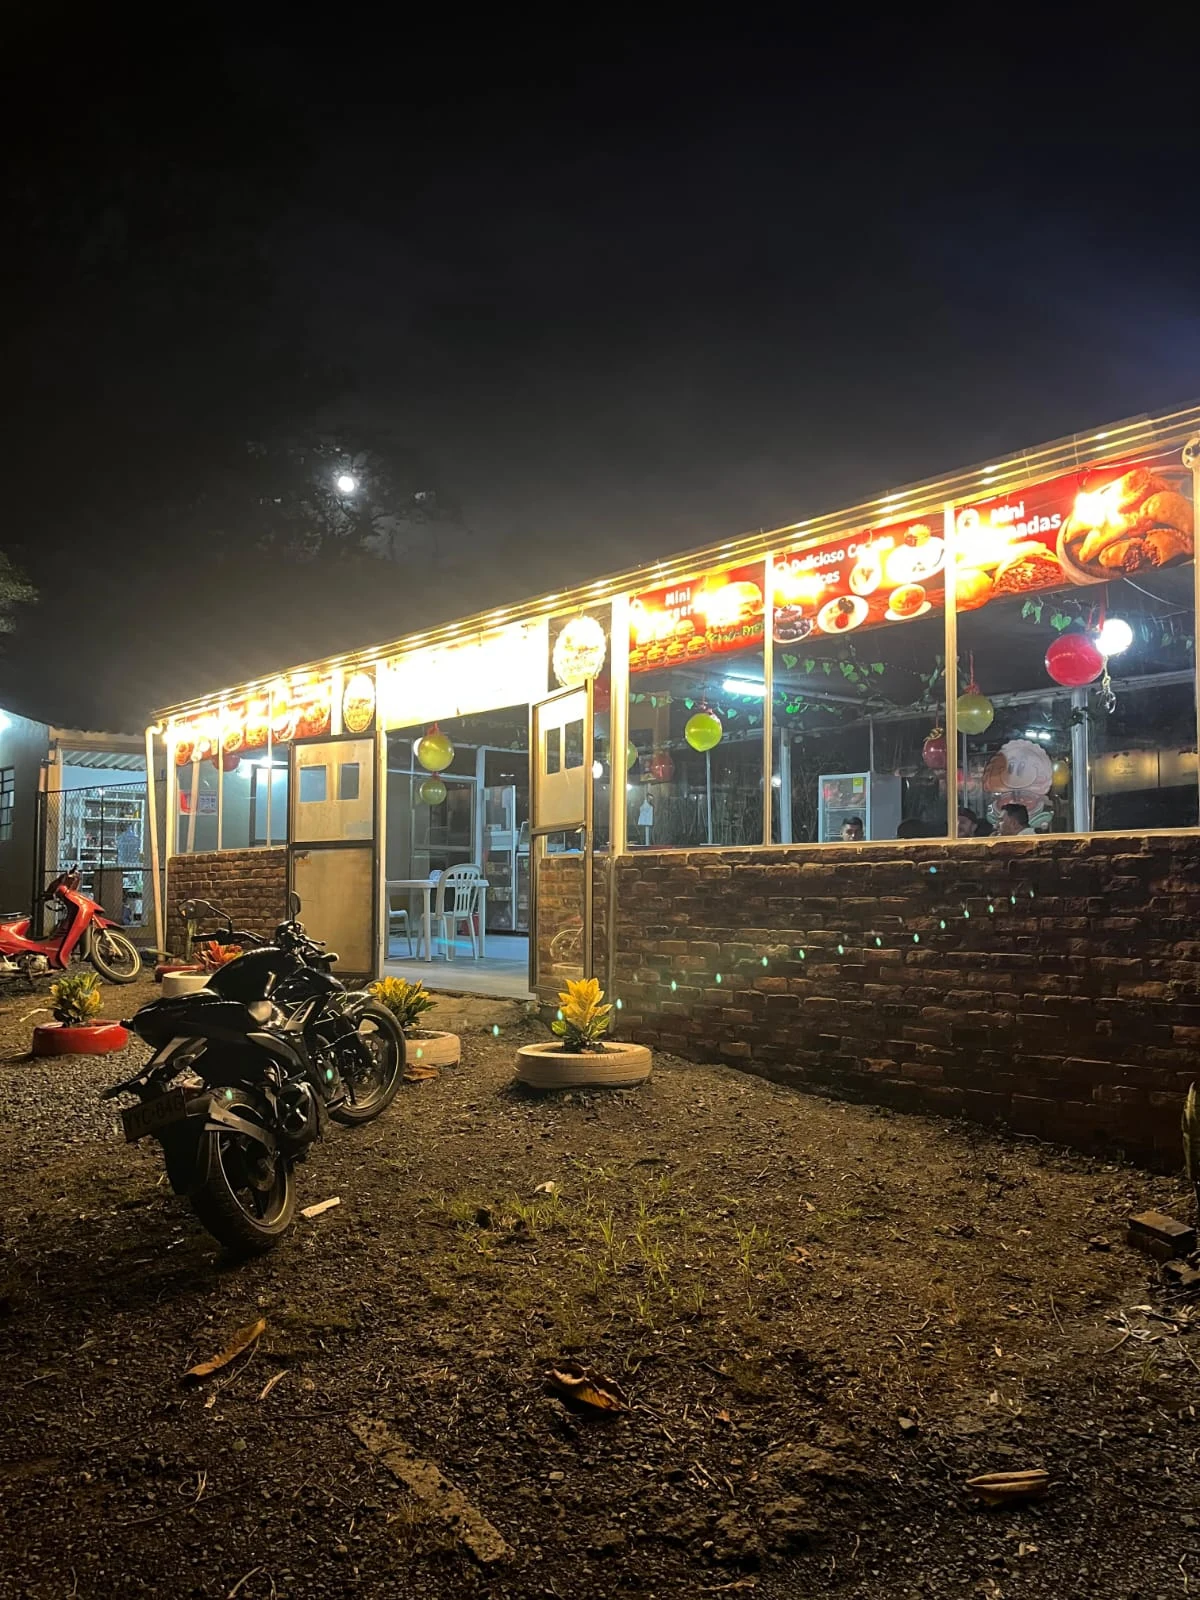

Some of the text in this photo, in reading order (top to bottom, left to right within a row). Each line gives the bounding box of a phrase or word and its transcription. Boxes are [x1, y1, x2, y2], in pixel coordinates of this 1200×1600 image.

[991, 501, 1024, 524] Mini
[791, 549, 845, 571] Delicioso
[665, 587, 691, 606] Mini
